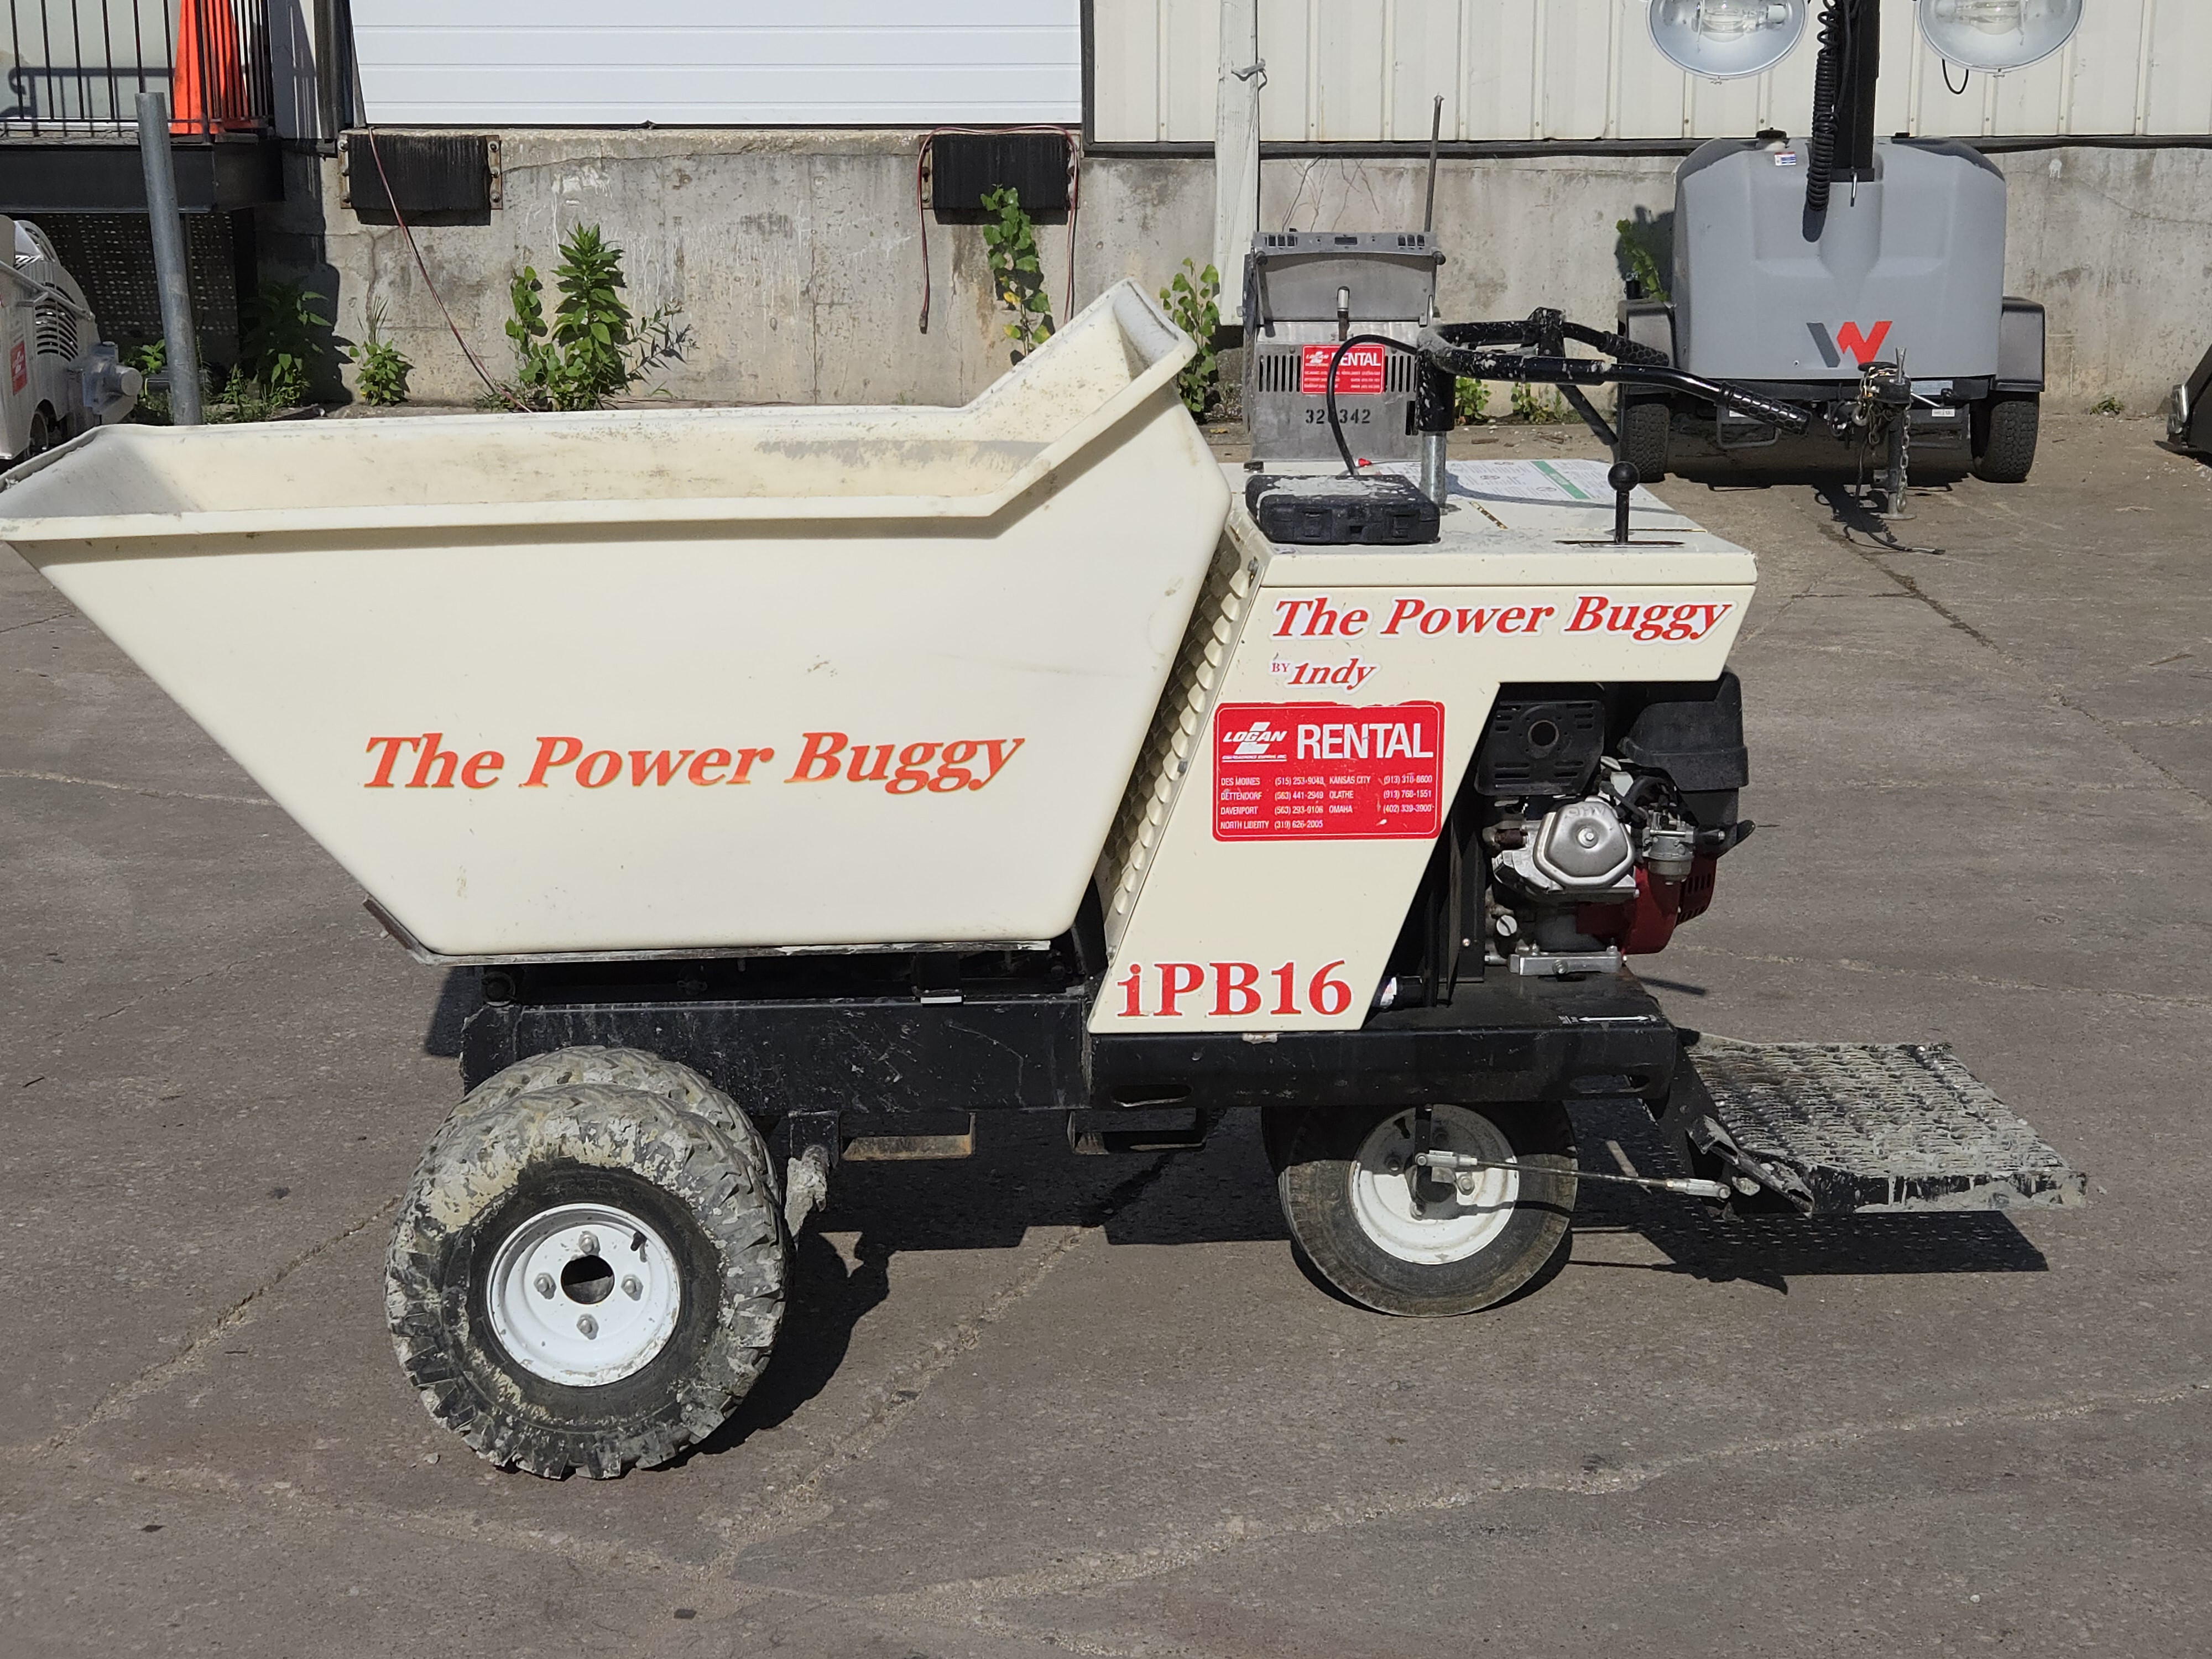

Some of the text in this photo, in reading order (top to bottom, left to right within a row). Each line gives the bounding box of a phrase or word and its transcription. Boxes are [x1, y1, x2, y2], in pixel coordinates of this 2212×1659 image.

[1306, 409, 1370, 424] 32342
[1273, 596, 1732, 641] The Power Buggy
[1272, 663, 1290, 672] BY
[1223, 731, 1287, 742] LOGAN
[1297, 723, 1433, 759] RENTAL
[363, 732, 1025, 795] The Power Buggy
[1235, 777, 1260, 785] MOINES
[1275, 777, 1291, 786] (515)
[1329, 776, 1355, 784] KANSAS
[1329, 791, 1354, 799] OLATHE
[1220, 806, 1258, 815] DAVENPORT
[1329, 805, 1353, 813] OMAHA
[1384, 804, 1399, 813] (402)
[1220, 821, 1243, 830] NORTH
[1117, 960, 1352, 1016] iPB16
